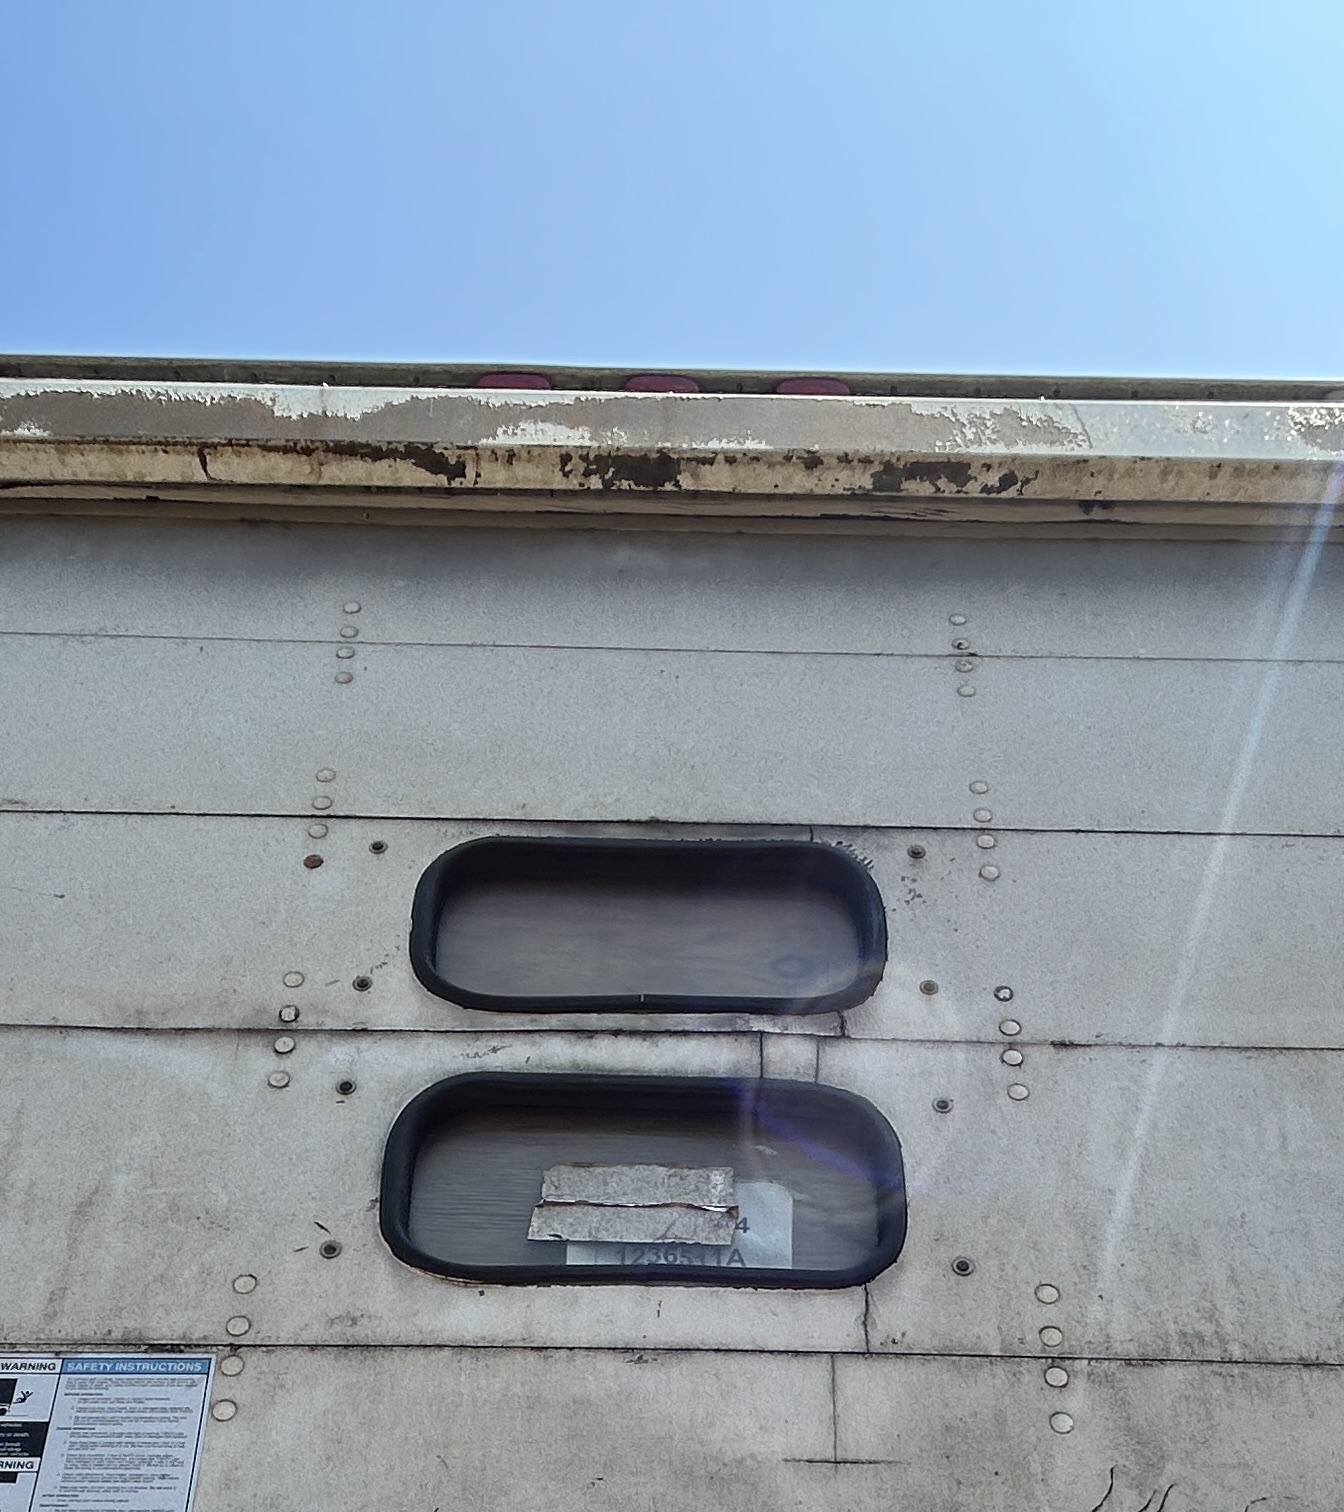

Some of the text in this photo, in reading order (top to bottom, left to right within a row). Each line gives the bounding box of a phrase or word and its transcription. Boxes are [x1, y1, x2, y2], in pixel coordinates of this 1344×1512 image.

[0, 1362, 56, 1371] WARNING
[66, 1361, 203, 1372] SAFETY INSTRUCTIONS
